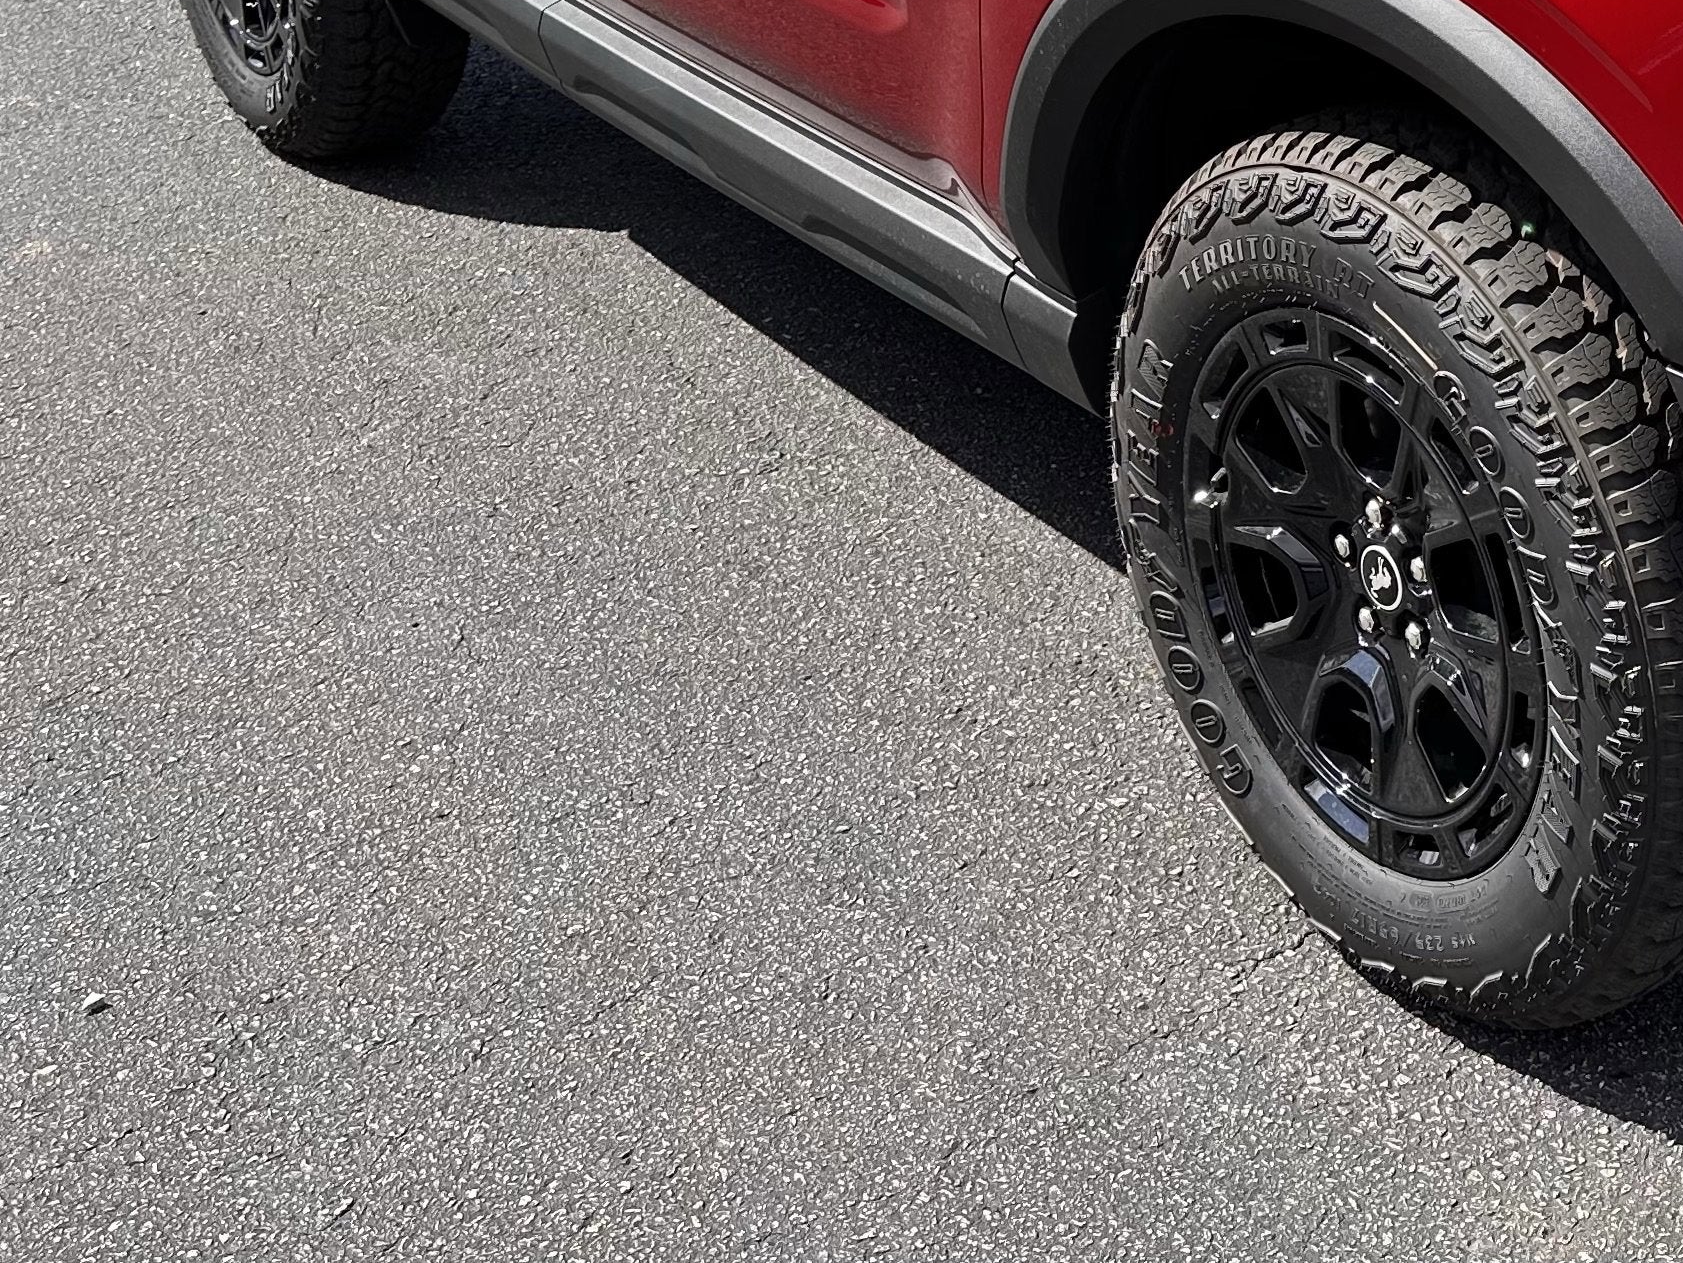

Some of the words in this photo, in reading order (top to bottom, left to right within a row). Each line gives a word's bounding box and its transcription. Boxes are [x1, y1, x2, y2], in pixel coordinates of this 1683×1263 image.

[1178, 233, 1317, 292] TERRITORY
[1211, 263, 1340, 299] ALL-TERRAIN
[1126, 338, 1253, 797] GOODYEAR
